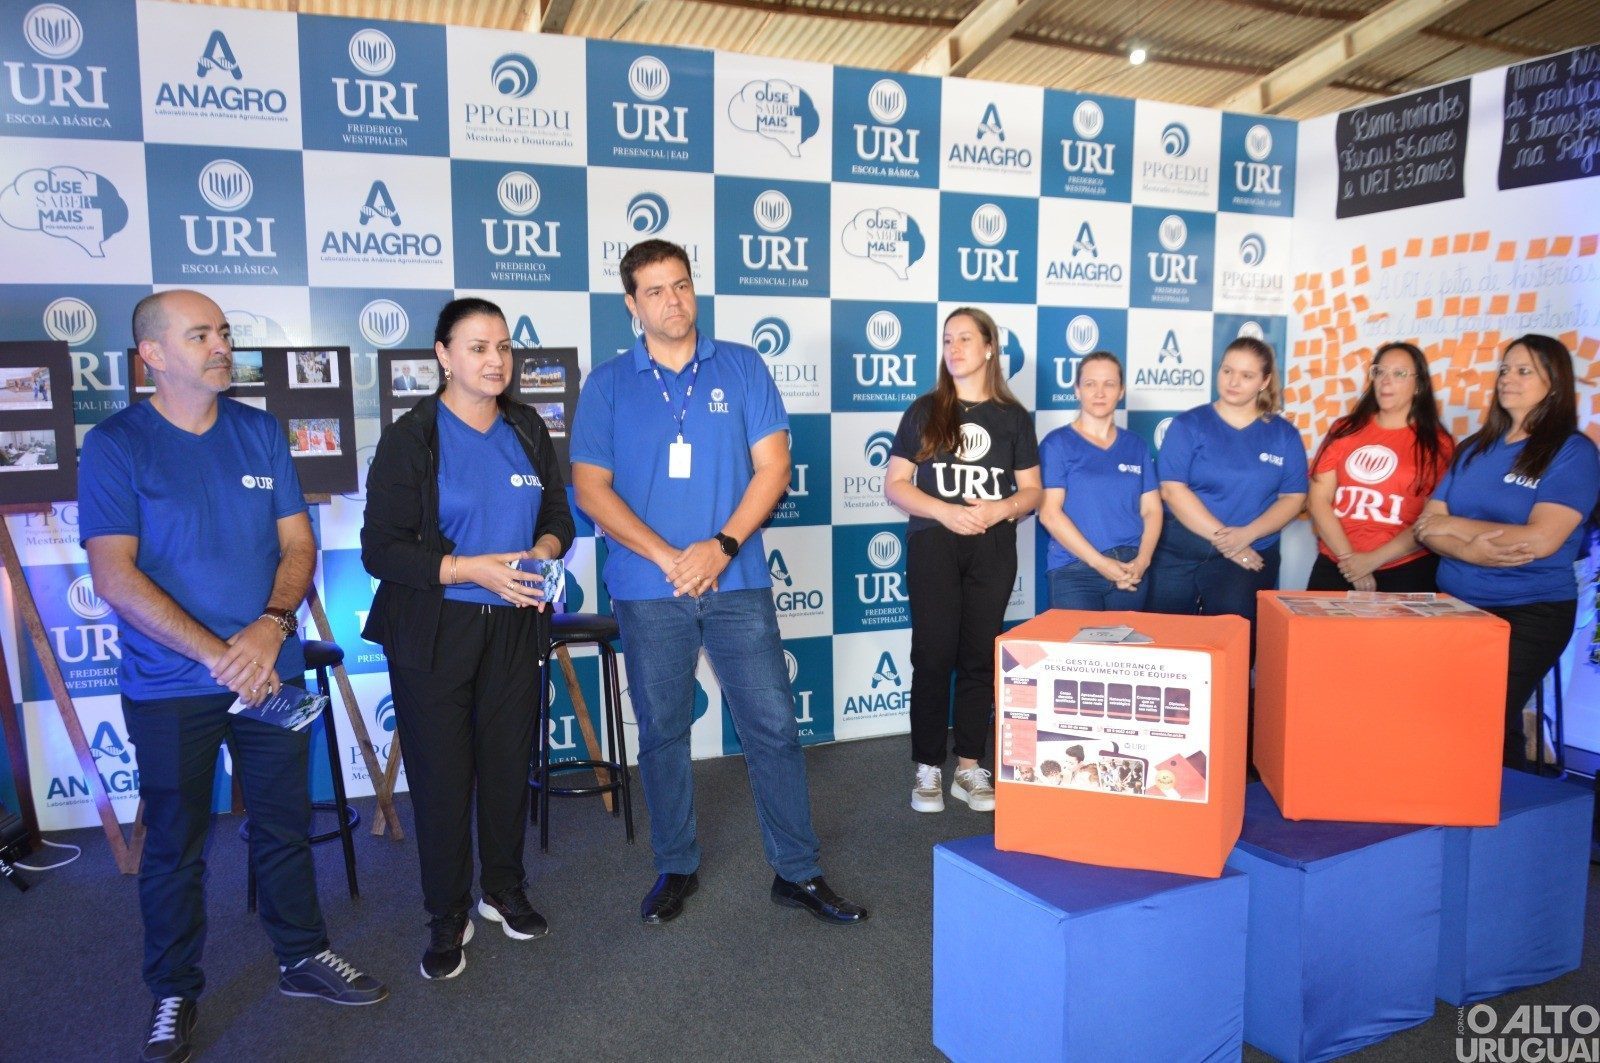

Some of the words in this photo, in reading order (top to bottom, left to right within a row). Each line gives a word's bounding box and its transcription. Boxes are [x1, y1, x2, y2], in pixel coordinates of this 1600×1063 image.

[3, 61, 109, 109] URI
[155, 83, 287, 114] ANAGRO
[332, 77, 419, 121] URI
[755, 89, 789, 103] OUSE
[6, 113, 60, 126] ESCOLA
[62, 114, 112, 128] BÁSICA
[464, 103, 571, 130] PPGEDU
[612, 101, 689, 144] URI
[757, 115, 788, 128] MAIS
[347, 124, 402, 135] FREDERICO
[342, 134, 408, 147] WESTPHALEN
[465, 132, 507, 144] Mestrado
[522, 136, 573, 147] Doutorado
[853, 123, 920, 165] URI
[613, 147, 666, 158] PRESENCIAL
[671, 150, 689, 160] EAD
[949, 144, 1032, 168] ANAGRO
[1061, 139, 1115, 176] URI
[852, 165, 886, 176] ESCOLA
[888, 166, 919, 178] BÁSICA
[1143, 161, 1208, 183] PPGEDU
[1234, 161, 1282, 194] URI
[34, 180, 83, 195] OUSE
[1361, 169, 1390, 196] URI
[36, 195, 94, 210] SABER
[39, 209, 84, 223] MAIS
[866, 217, 897, 230] OUSE
[180, 214, 277, 258] URI
[321, 230, 442, 257] ANAGRO
[482, 218, 561, 258] URI
[739, 234, 808, 271] URI
[867, 241, 896, 253] MAIS
[182, 263, 231, 275] ESCOLA
[234, 262, 279, 276] BÁSICA
[495, 261, 546, 272] FREDERICO
[958, 247, 1019, 283] URI
[1046, 260, 1123, 282] ANAGRO
[1148, 252, 1198, 285] URI
[490, 271, 551, 282] WESTPHALEN
[739, 277, 787, 287] PRESENCIAL
[792, 278, 808, 287] EAD
[71, 351, 125, 391] RI
[853, 354, 916, 387] URI
[1135, 368, 1204, 386] ANAGRO
[104, 401, 127, 410] EAD
[853, 393, 896, 401] PRESENCIAL
[901, 393, 917, 401] EAD
[708, 403, 729, 413] URI
[932, 462, 1004, 500] URI
[844, 500, 878, 508] Mestrado
[1334, 486, 1404, 525] URI
[855, 572, 909, 603] UR
[776, 590, 823, 611] GRO
[861, 615, 909, 625] WESTPHALEN
[865, 607, 905, 616] FREDERICO
[50, 624, 122, 663] UR
[70, 667, 119, 678] FREDERIC
[1045, 664, 1131, 676] DESENVOLVIMENTO
[1148, 671, 1188, 680] EQUIPES
[1106, 661, 1157, 672] LIDERANÇA
